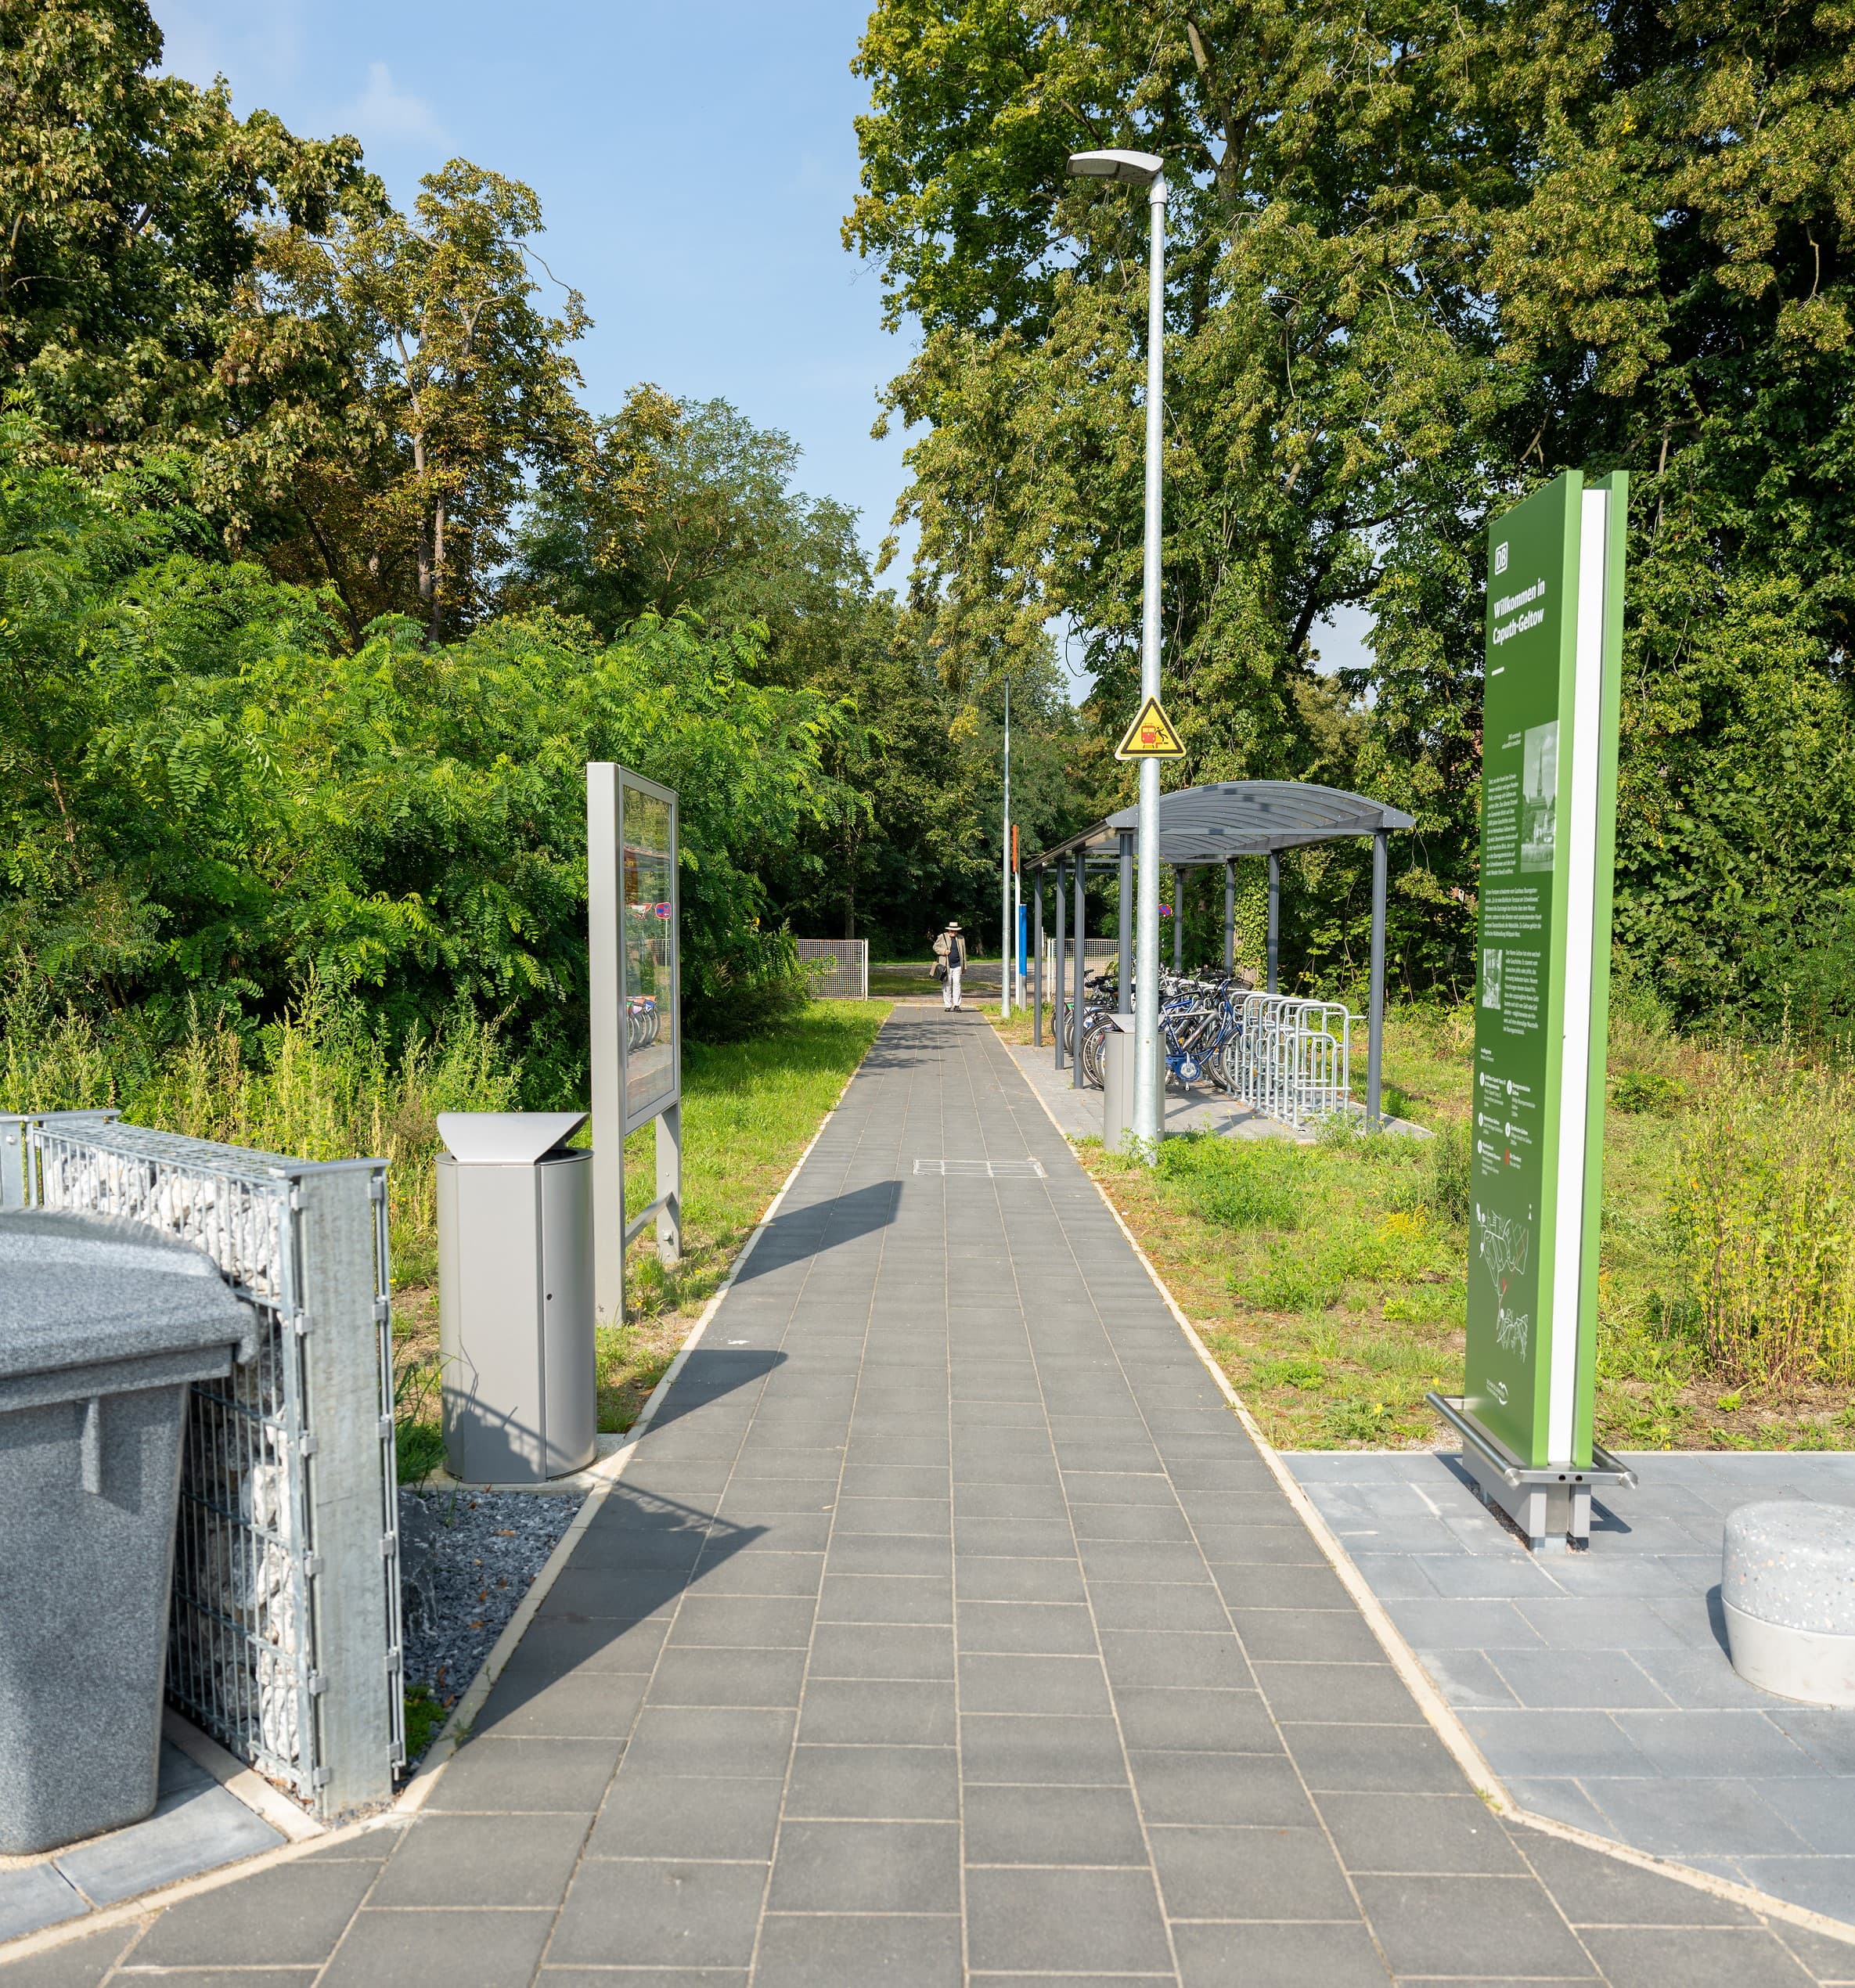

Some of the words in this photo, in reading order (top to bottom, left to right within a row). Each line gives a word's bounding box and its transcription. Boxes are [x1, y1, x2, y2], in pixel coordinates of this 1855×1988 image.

[1497, 546, 1507, 571] DB
[1493, 585, 1536, 619] Willkommen
[1537, 577, 1545, 597] in
[1493, 607, 1544, 646] Caputh-Geltow
